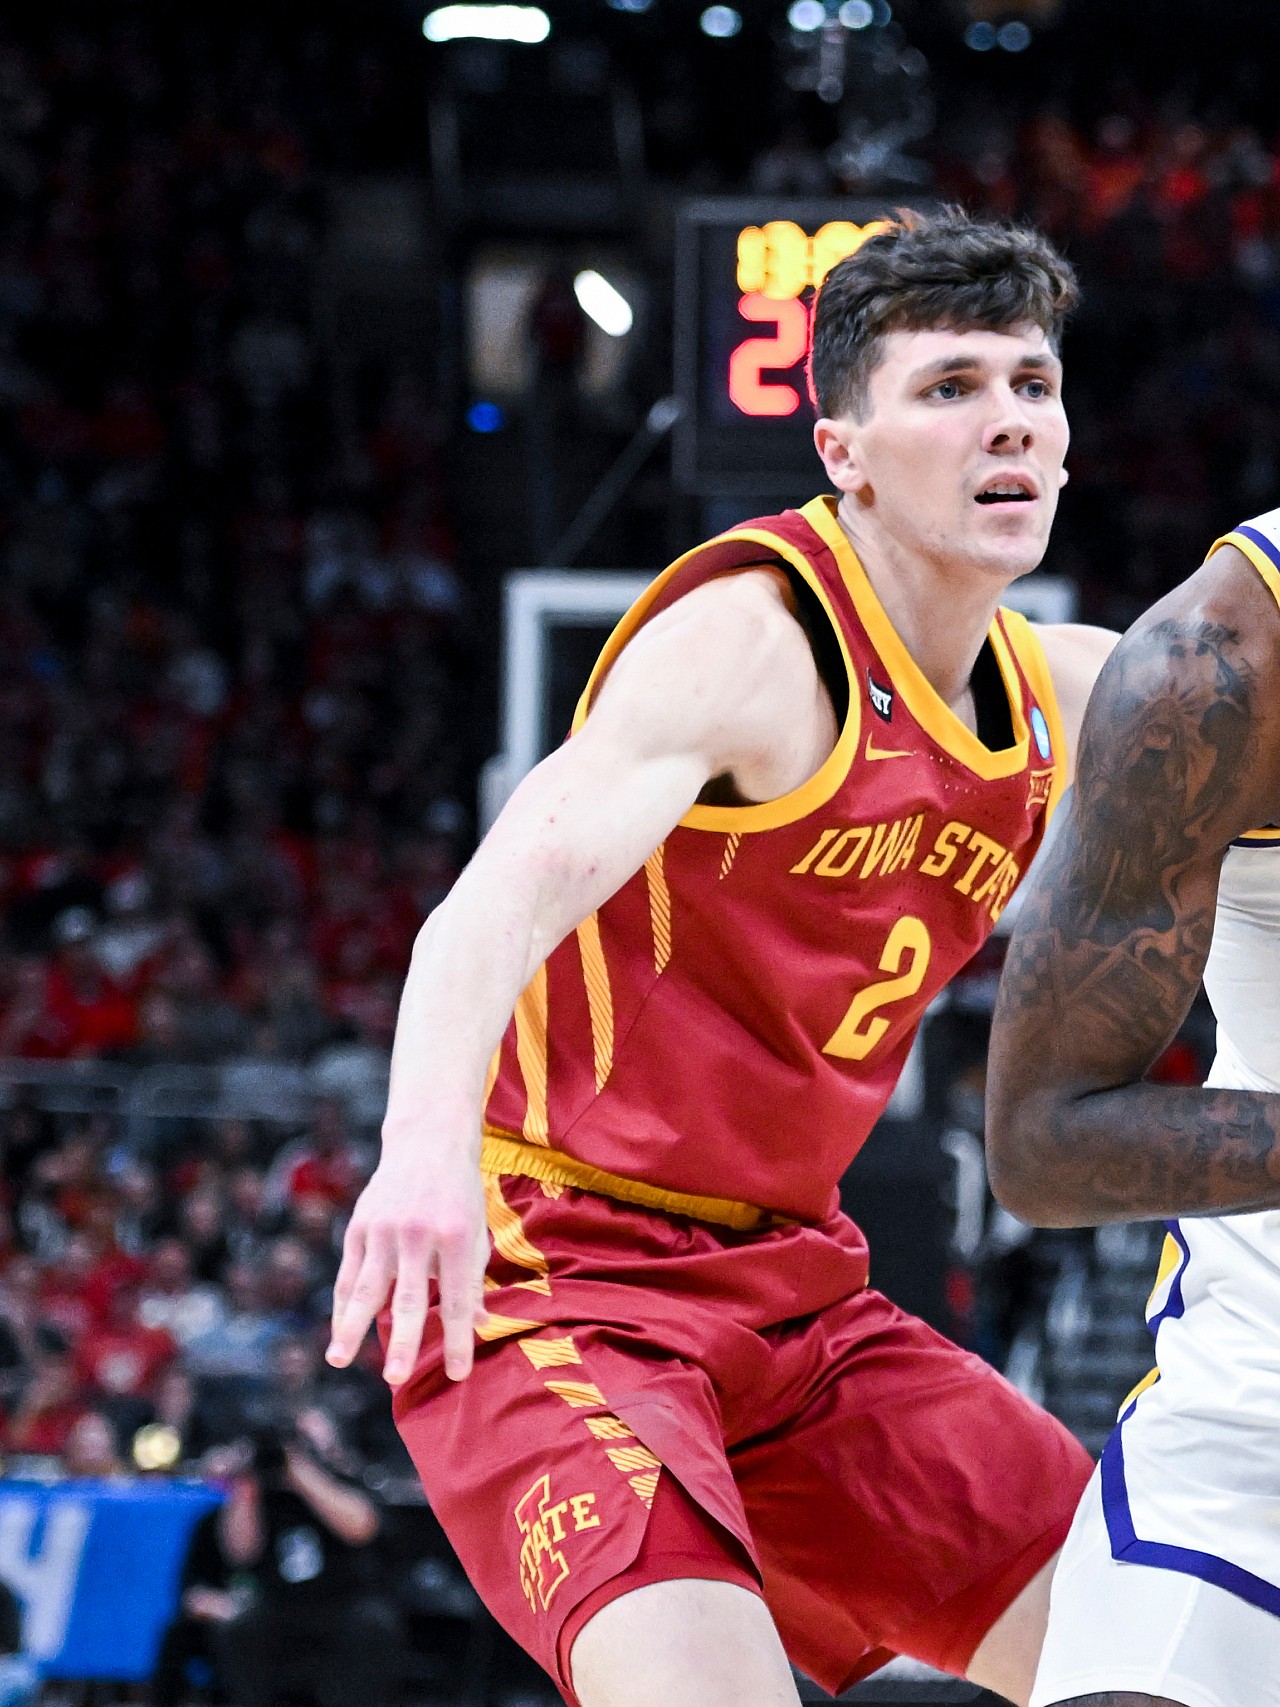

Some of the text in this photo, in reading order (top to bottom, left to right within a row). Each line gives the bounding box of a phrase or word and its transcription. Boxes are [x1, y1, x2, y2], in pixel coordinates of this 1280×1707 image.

[729, 293, 818, 416] 2
[789, 814, 924, 879] IOWA
[821, 915, 931, 1061] 2
